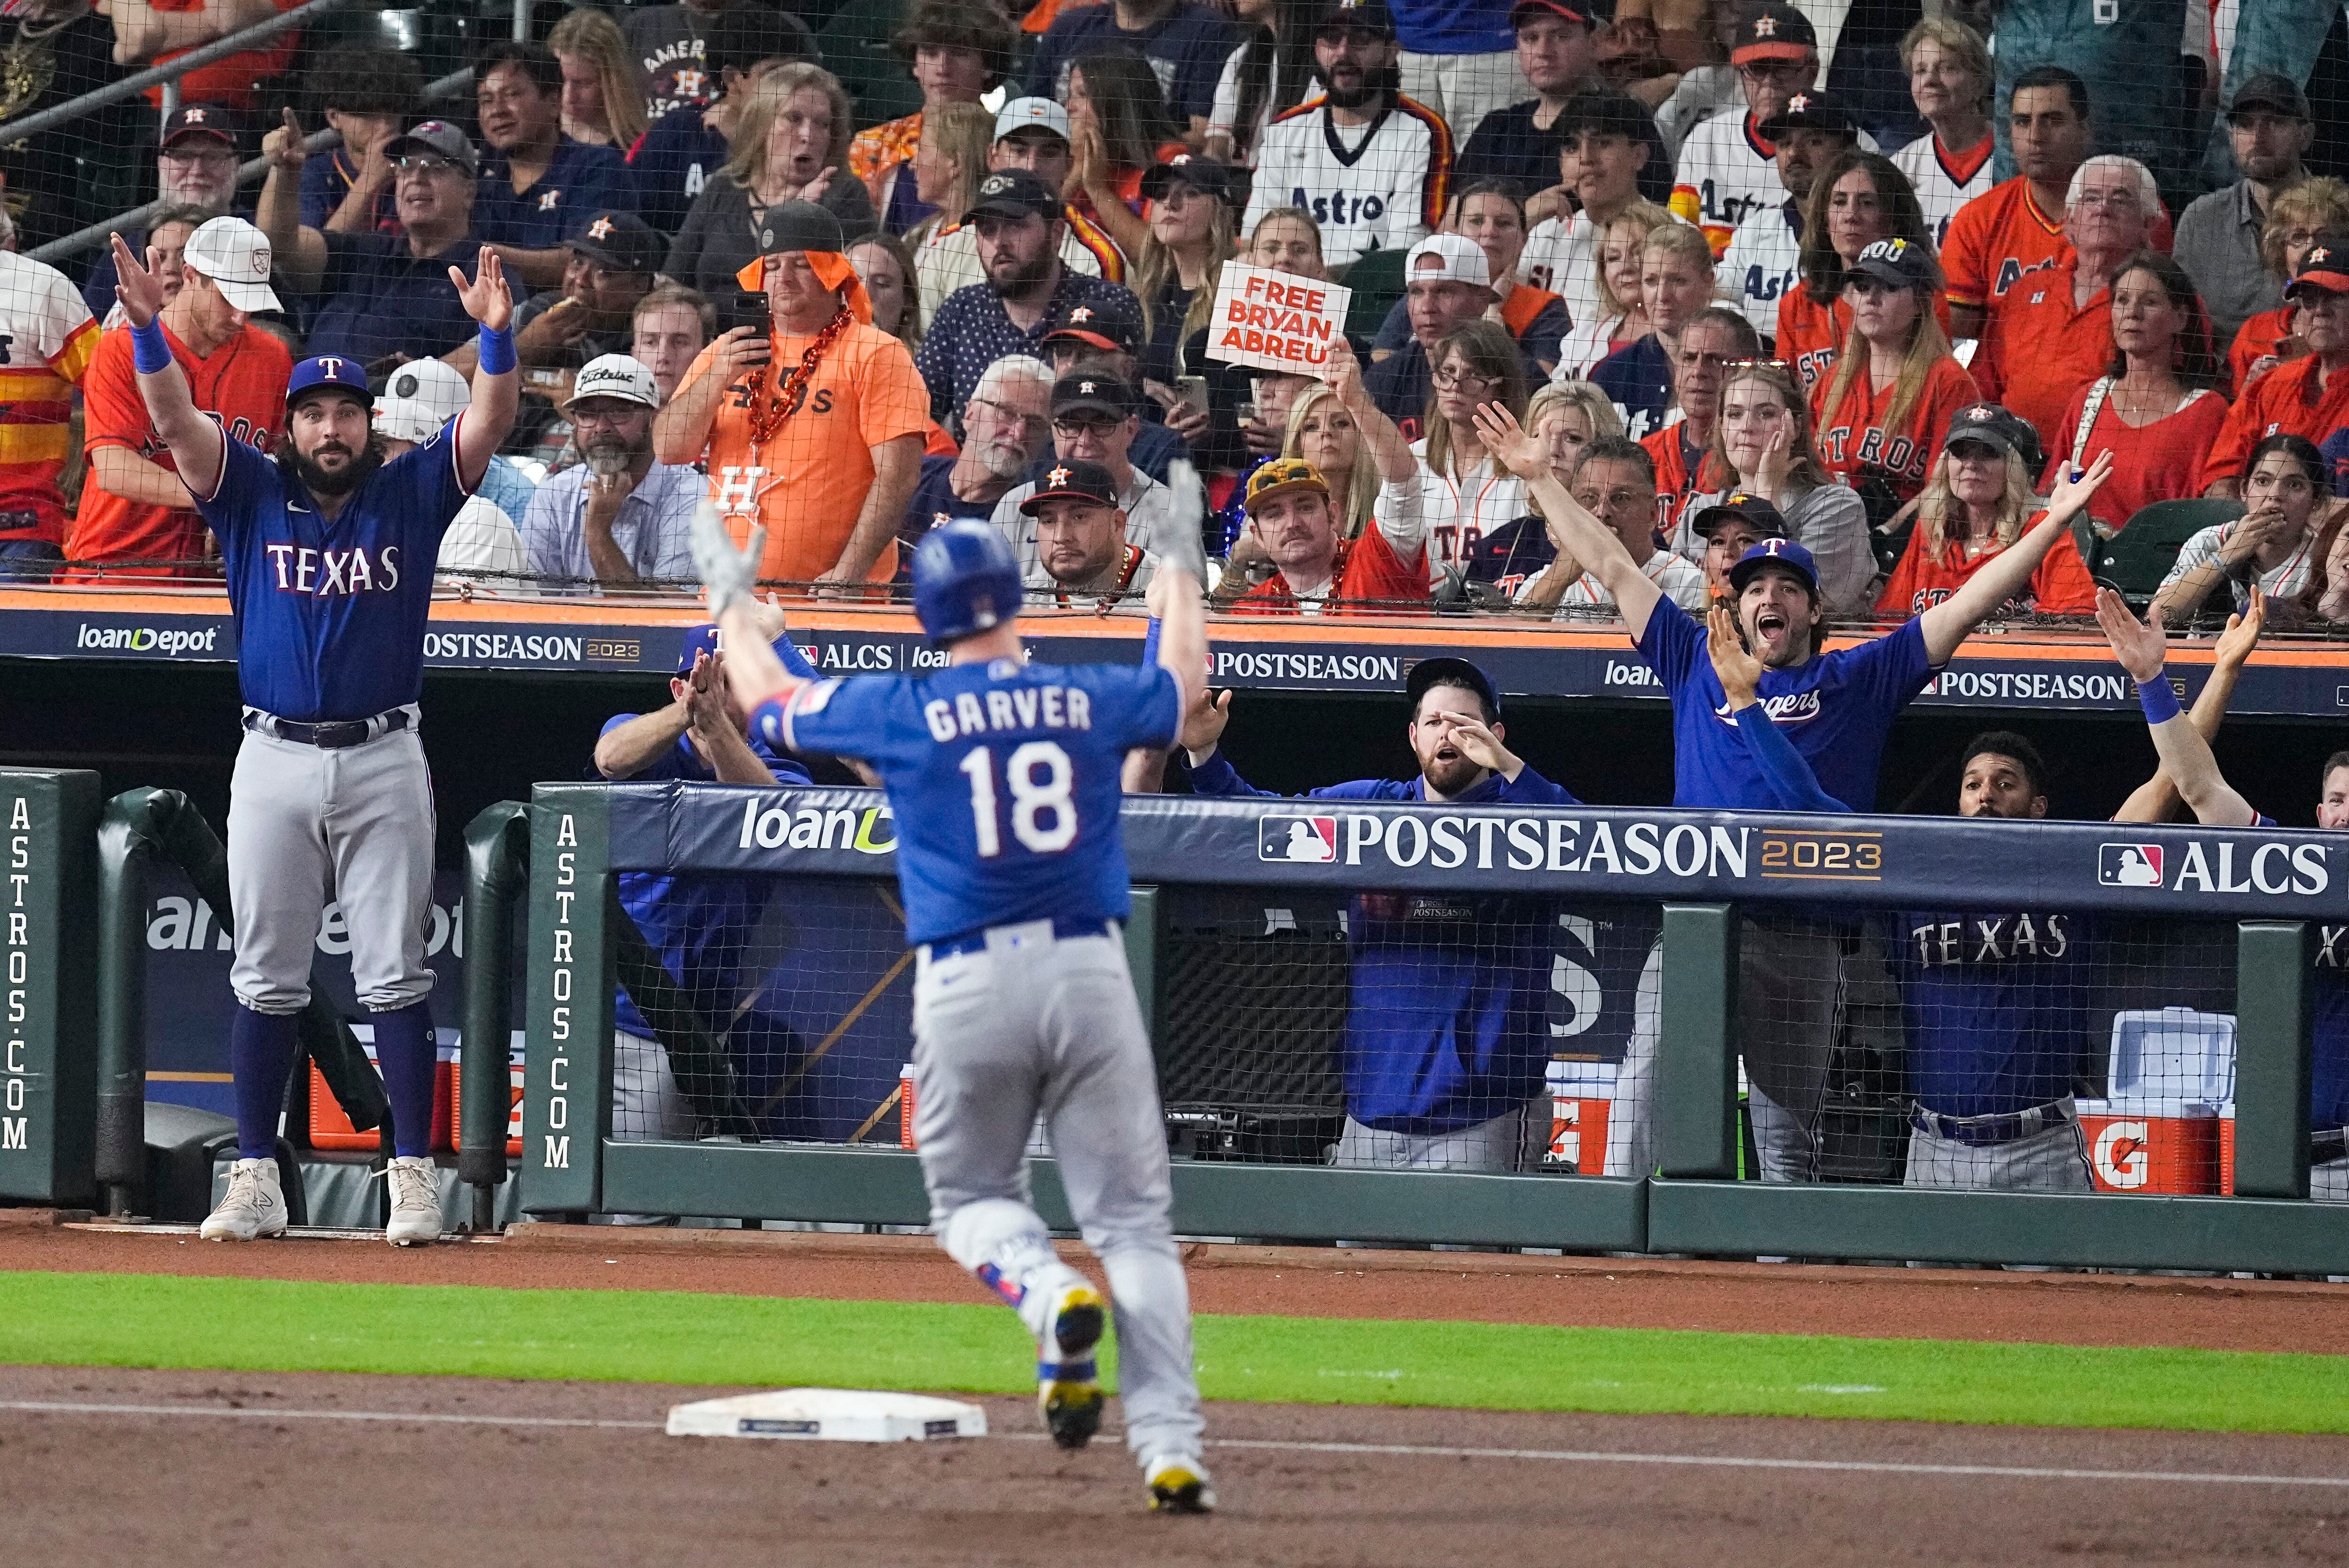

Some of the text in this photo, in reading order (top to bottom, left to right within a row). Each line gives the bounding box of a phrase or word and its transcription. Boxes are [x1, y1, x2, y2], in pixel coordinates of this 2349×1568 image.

[1245, 276, 1326, 314] FREE
[1228, 299, 1332, 341] BRYAN
[1220, 326, 1328, 364] ABREU
[319, 357, 343, 380] T
[1762, 538, 1787, 557] T
[267, 544, 399, 596] TEXAS
[77, 623, 218, 656] loanDepot
[424, 632, 640, 661] OSTSEASON 2023
[822, 644, 893, 669] ALCS
[1218, 652, 1398, 681] POSTSEASON
[1941, 671, 2126, 701] POSTSEASON
[924, 685, 1092, 743] GARVER
[960, 741, 1078, 858] 18
[1346, 815, 1882, 878] POSTSEASON 2023
[2173, 842, 2329, 895] ALCS
[1913, 913, 2069, 969] TEXAS
[2094, 1121, 2148, 1189] G
